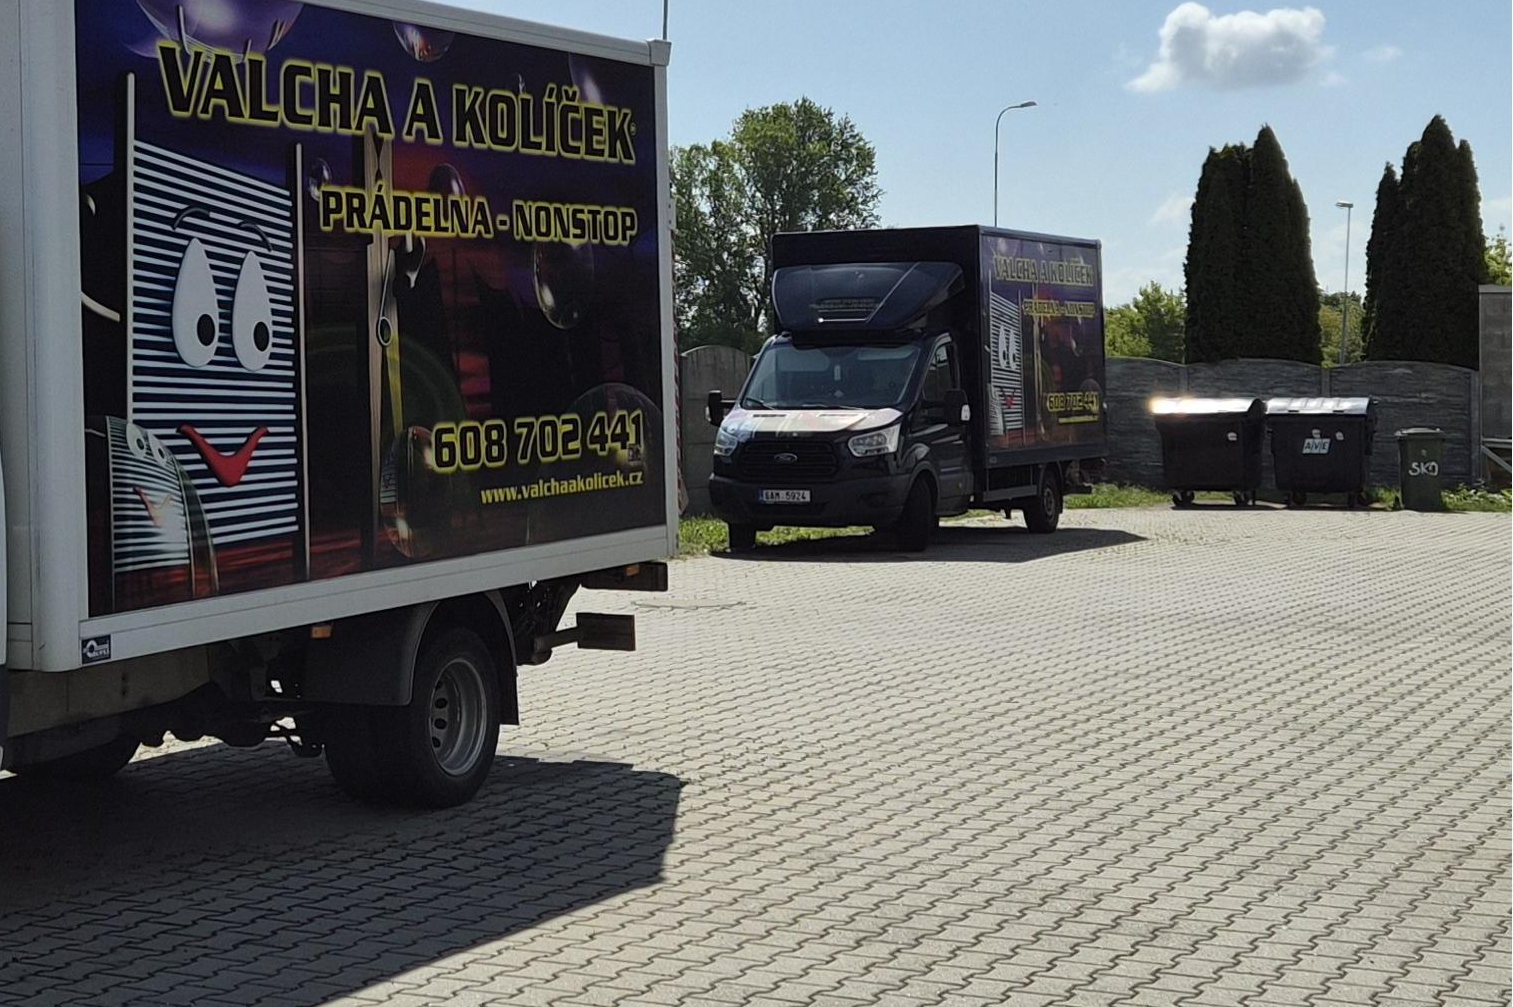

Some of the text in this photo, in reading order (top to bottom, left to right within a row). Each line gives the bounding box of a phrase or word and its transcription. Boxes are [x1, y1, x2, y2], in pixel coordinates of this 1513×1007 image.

[157, 41, 636, 164] VALCHA A KOLÍČEK
[319, 184, 494, 239] PRÁDELNA
[512, 200, 638, 244] NONSTOP
[430, 409, 643, 473] 608 702 441
[480, 470, 643, 504] www.valchaakolicek.cz
